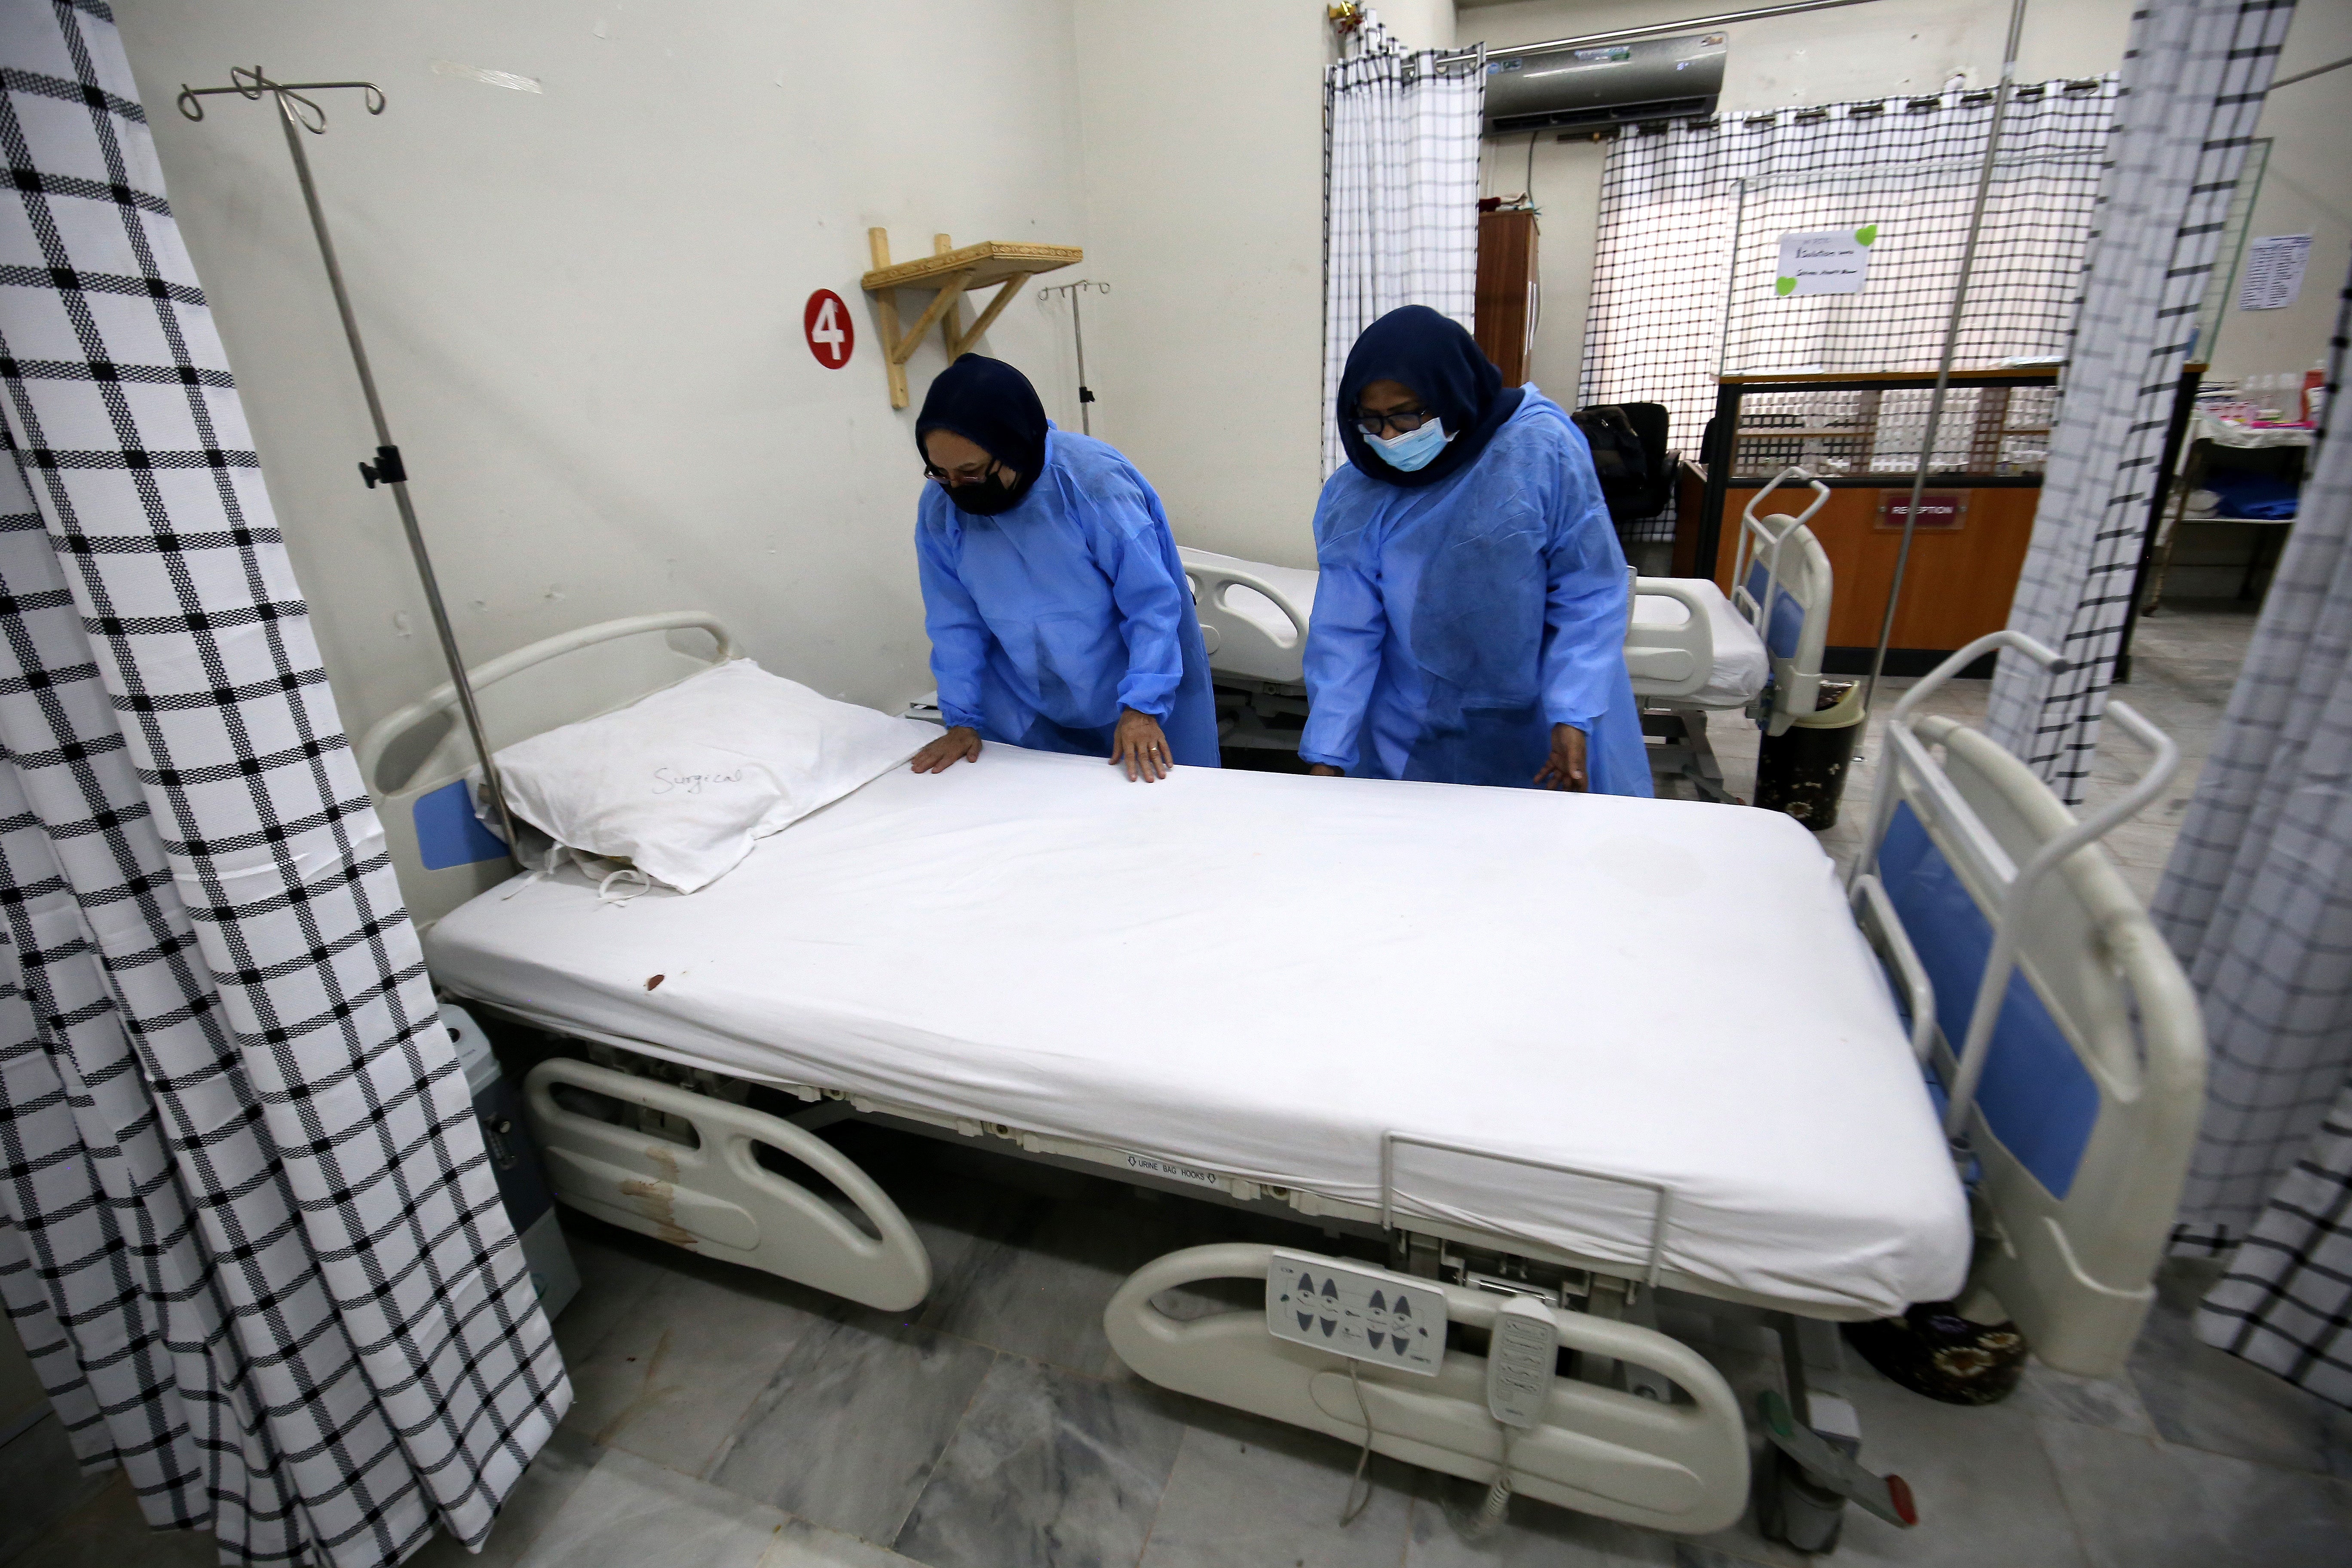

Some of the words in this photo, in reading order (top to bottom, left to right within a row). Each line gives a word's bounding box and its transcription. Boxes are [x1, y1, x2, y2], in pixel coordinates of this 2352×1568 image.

[812, 298, 845, 360] 4
[652, 767, 742, 794] Surgical
[1139, 1160, 1158, 1170] URINE
[1163, 1165, 1176, 1174] BAG
[1181, 1169, 1204, 1180] HOOKS
